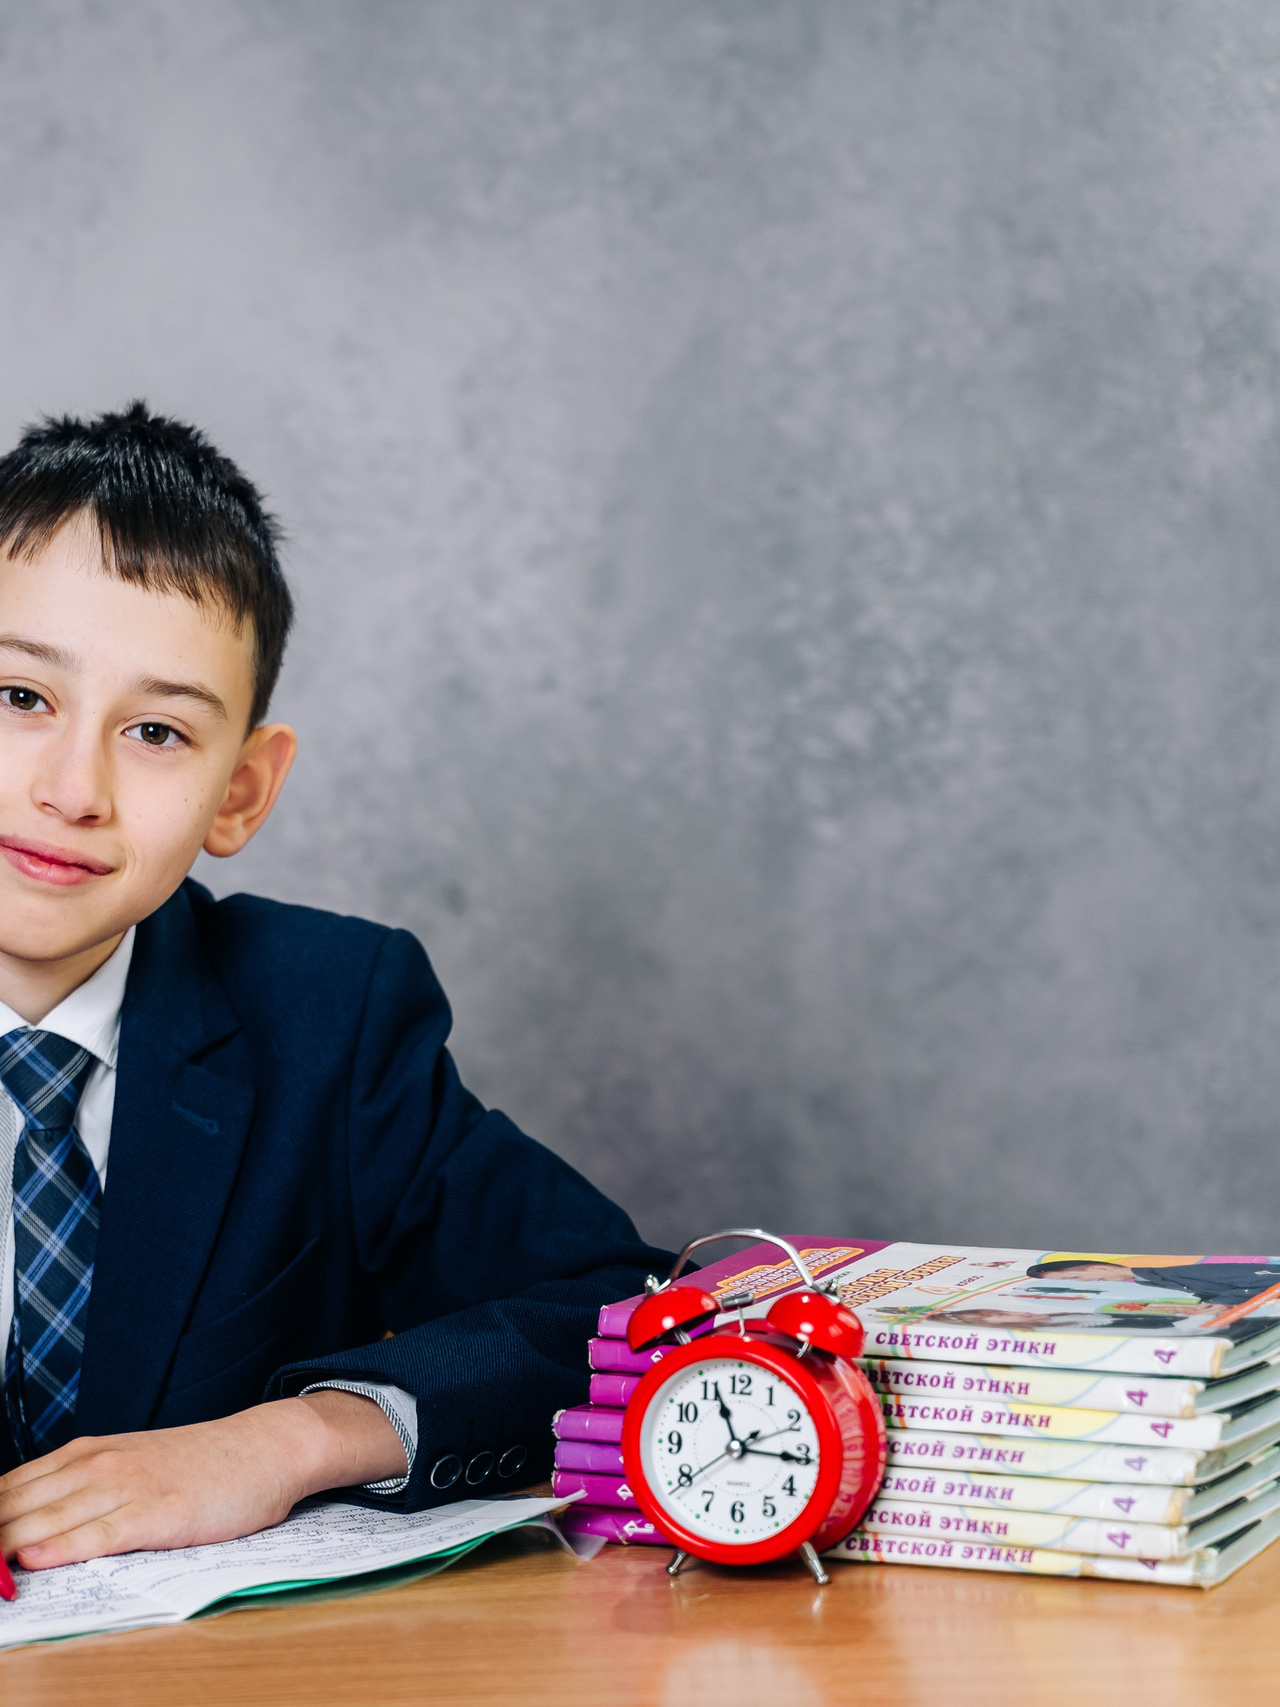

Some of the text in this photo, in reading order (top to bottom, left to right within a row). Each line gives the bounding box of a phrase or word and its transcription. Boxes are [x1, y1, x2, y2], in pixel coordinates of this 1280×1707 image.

[893, 1255, 967, 1281] ЭТИКИ
[875, 1332, 979, 1350] СВЕТСКОЙ
[986, 1338, 1057, 1355] ЭТИКИ
[1153, 1349, 1177, 1364] 4
[700, 1379, 720, 1401] 11
[728, 1374, 752, 1396] 12
[863, 1368, 1030, 1395] ВЕТСКОЙ ЭТИКИ
[766, 1386, 775, 1406] 1
[1126, 1389, 1148, 1406] 4
[677, 1401, 698, 1423] 10
[787, 1409, 801, 1431] 2
[882, 1403, 1052, 1428] ВЕТСКОЙ ЭТИКИ
[1150, 1421, 1174, 1439] 4
[668, 1430, 682, 1454] 9
[887, 1440, 1025, 1463] СКОЙ ЭТИКИ
[796, 1443, 811, 1466] 3
[1124, 1456, 1148, 1472] 4
[678, 1464, 693, 1487] 8
[782, 1474, 797, 1496] 4
[882, 1476, 1014, 1501] СКОЙ ЭТИКИ
[701, 1490, 714, 1512] 7
[730, 1500, 745, 1523] 6
[762, 1495, 776, 1517] 5
[1113, 1496, 1135, 1513] 4
[868, 1510, 1009, 1536] ТСКОЙ ЭТИКИ
[845, 1538, 1035, 1564] СВЕТСКОЙ ЭТИКИ
[1107, 1531, 1131, 1549] 4
